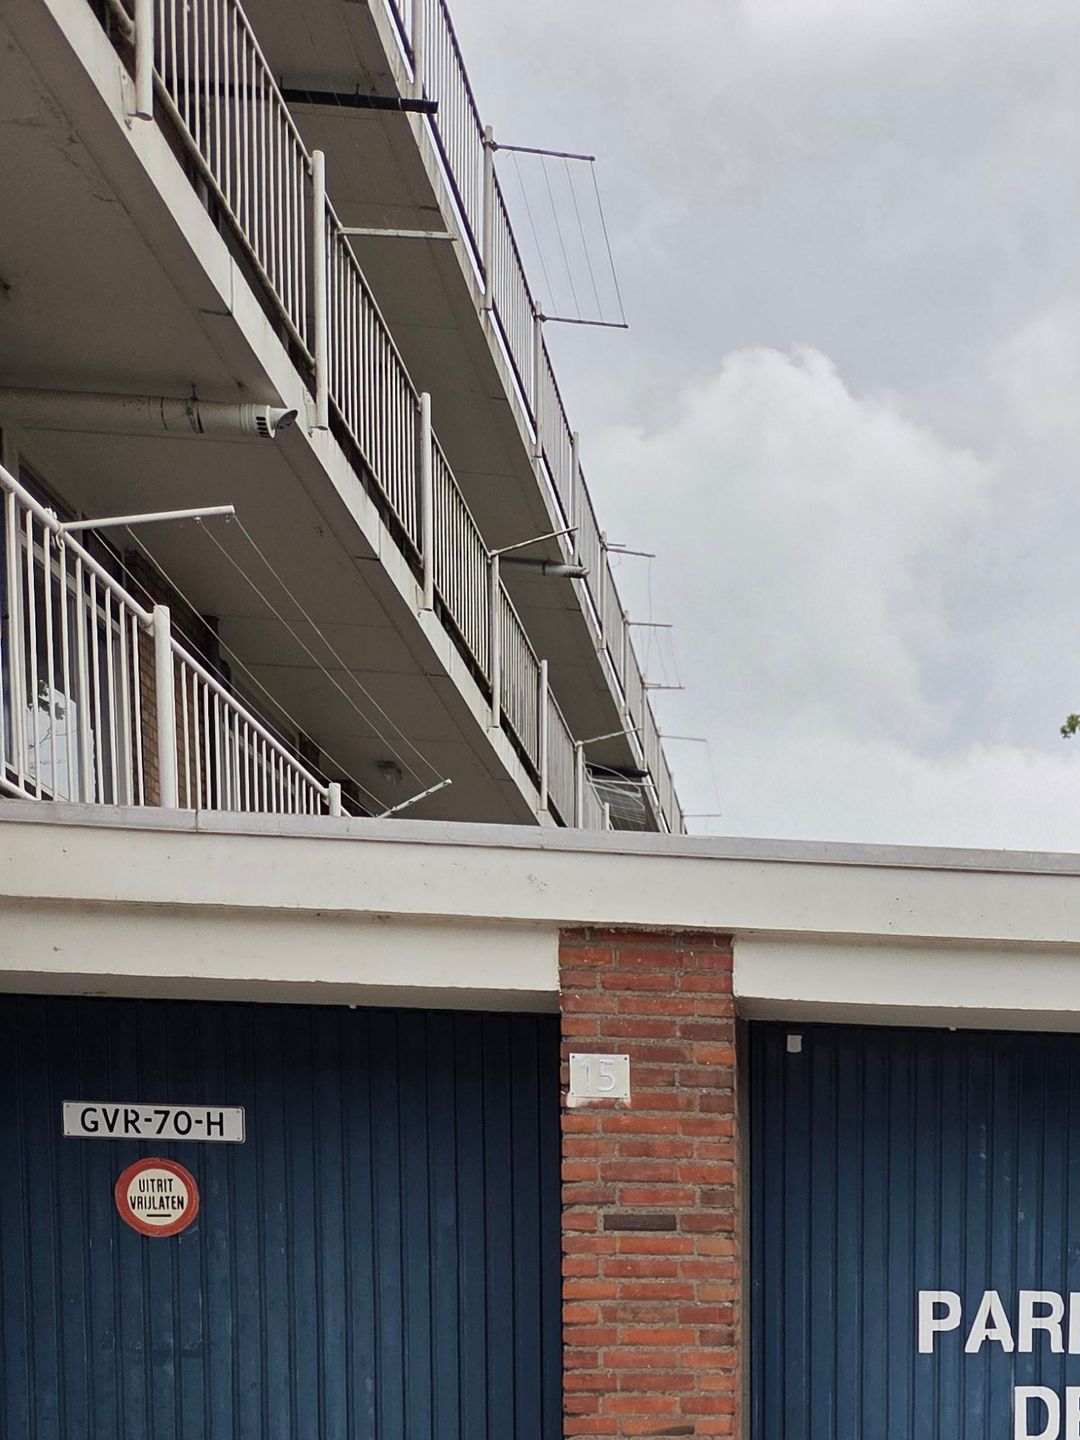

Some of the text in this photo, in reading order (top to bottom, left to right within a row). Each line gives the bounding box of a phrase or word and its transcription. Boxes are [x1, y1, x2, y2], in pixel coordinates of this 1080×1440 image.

[580, 1059, 616, 1092] 15
[80, 1107, 224, 1136] GVR-70-H
[138, 1178, 174, 1193] UITRIT
[129, 1195, 185, 1210] VRIJLATEN
